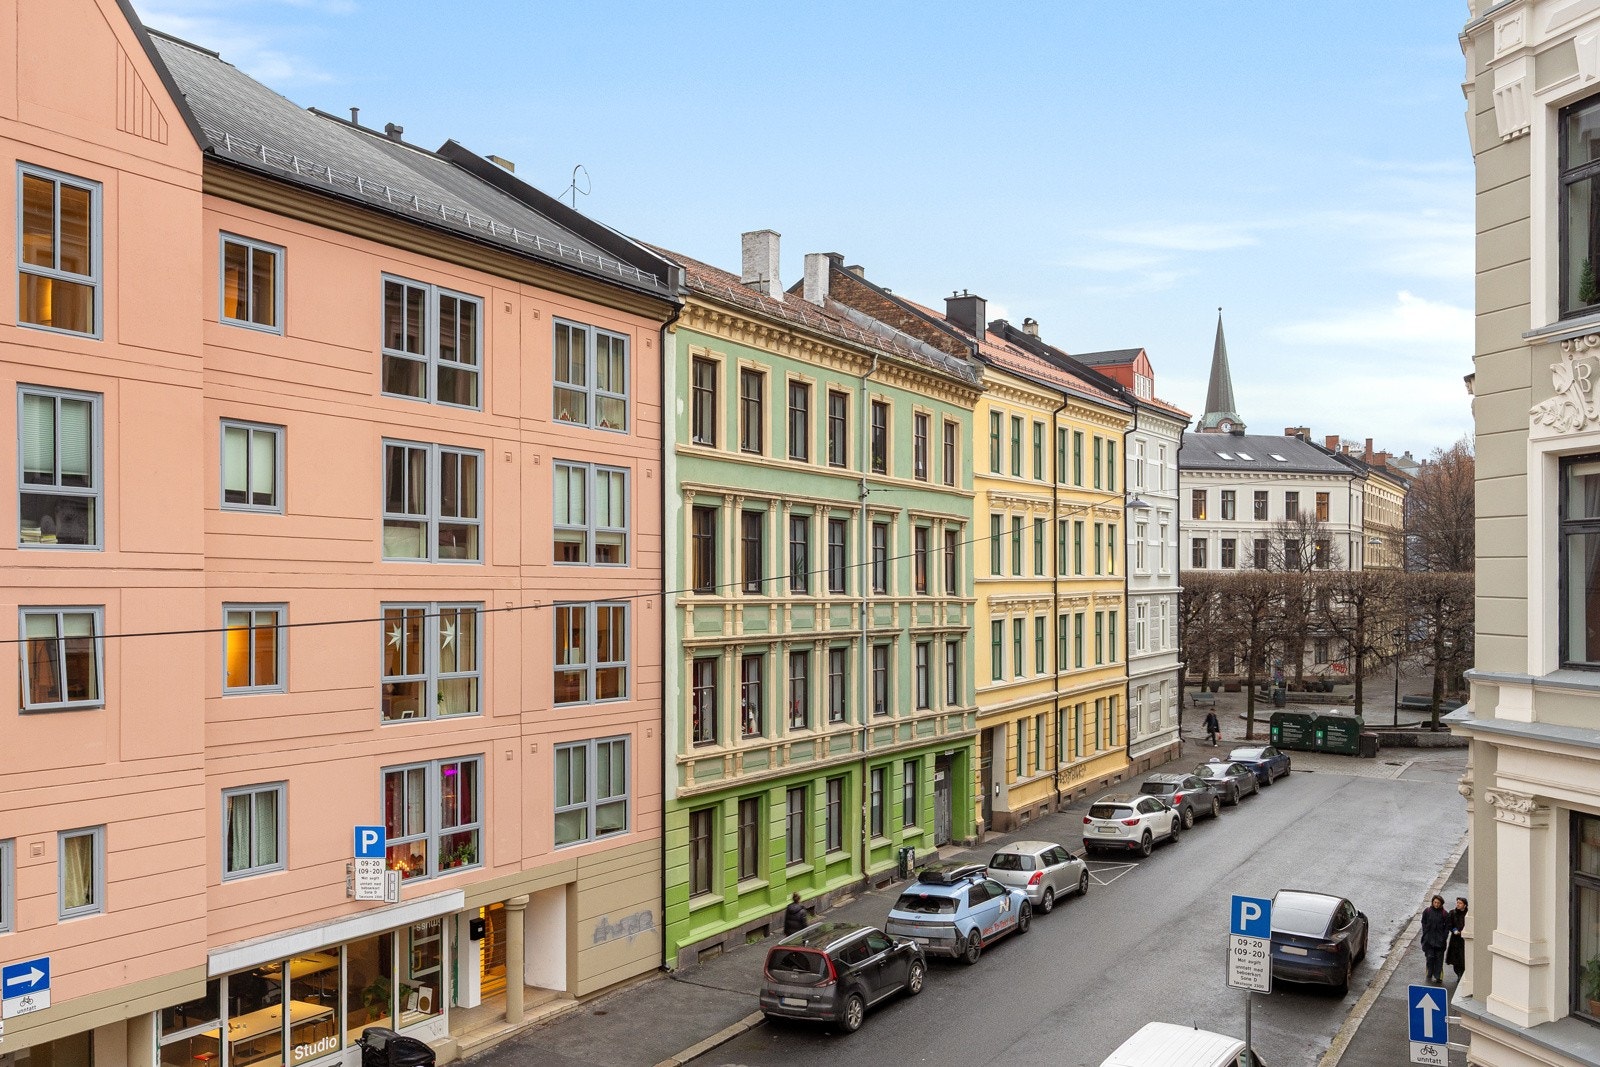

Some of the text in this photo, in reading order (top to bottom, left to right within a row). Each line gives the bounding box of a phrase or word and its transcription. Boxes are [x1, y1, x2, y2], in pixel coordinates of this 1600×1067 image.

[1574, 362, 1592, 393] B
[361, 829, 379, 854] P
[1240, 901, 1262, 931] P
[16, 1004, 37, 1014] unntatt
[294, 1036, 337, 1060] Studio
[1417, 1056, 1442, 1065] unntatt
